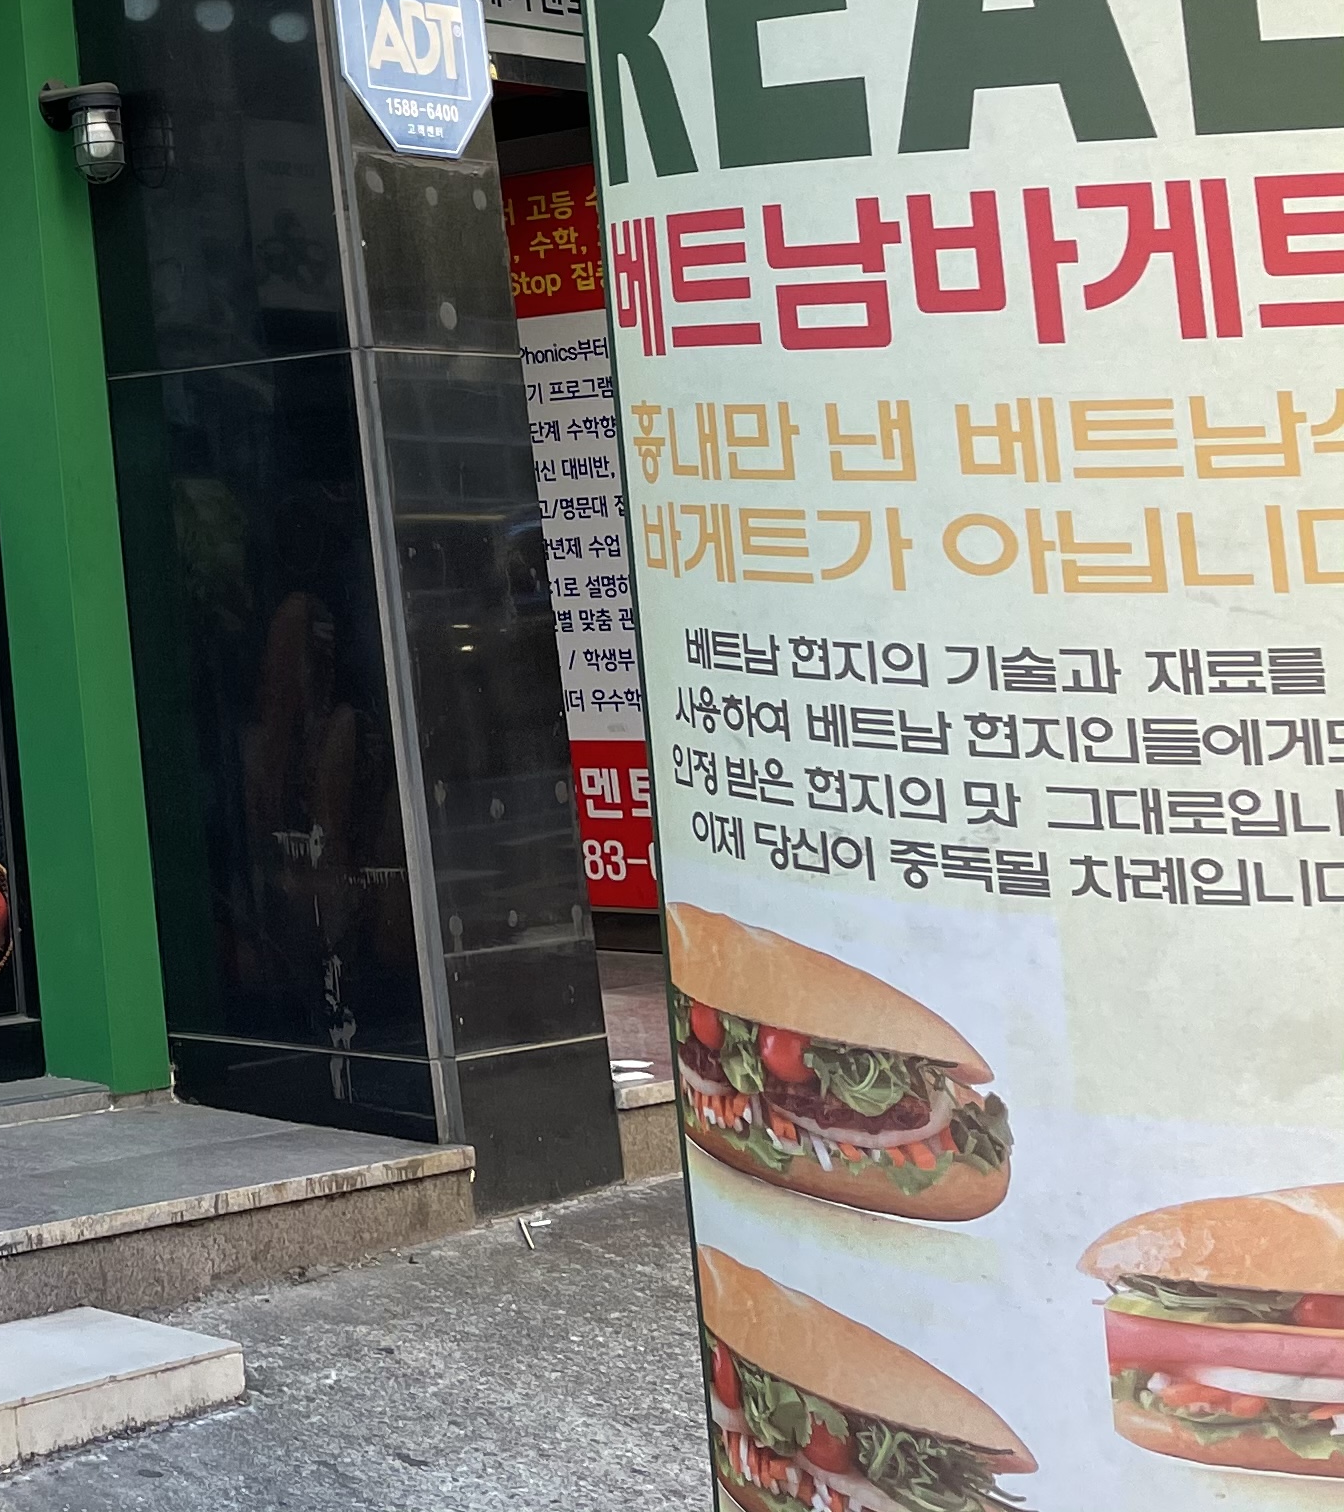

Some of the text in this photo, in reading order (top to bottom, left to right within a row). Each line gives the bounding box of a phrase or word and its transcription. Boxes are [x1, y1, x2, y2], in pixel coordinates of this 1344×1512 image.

[386, 97, 459, 122] 1588-6400
[526, 190, 575, 220] 고등
[611, 174, 1344, 356] 베트남바게트
[549, 376, 614, 401] 프로그램
[825, 399, 917, 482] 낸
[588, 535, 621, 558] 수업
[642, 502, 913, 591] 바게트가
[553, 610, 574, 632] 별
[579, 608, 612, 631] 맞춤
[583, 648, 635, 672] 학생부
[685, 628, 1326, 696] 베트남 현지의 기술과 재료를
[675, 686, 790, 742] 사용하여
[806, 703, 952, 755] 베트남
[672, 744, 718, 796] 인정
[725, 758, 794, 807] 받은
[804, 766, 947, 824] 현지의
[963, 781, 1021, 828] 맛
[582, 839, 657, 881] 83-
[692, 811, 746, 860] 이제
[754, 821, 876, 881] 당신이
[889, 838, 1052, 898] 중독될
